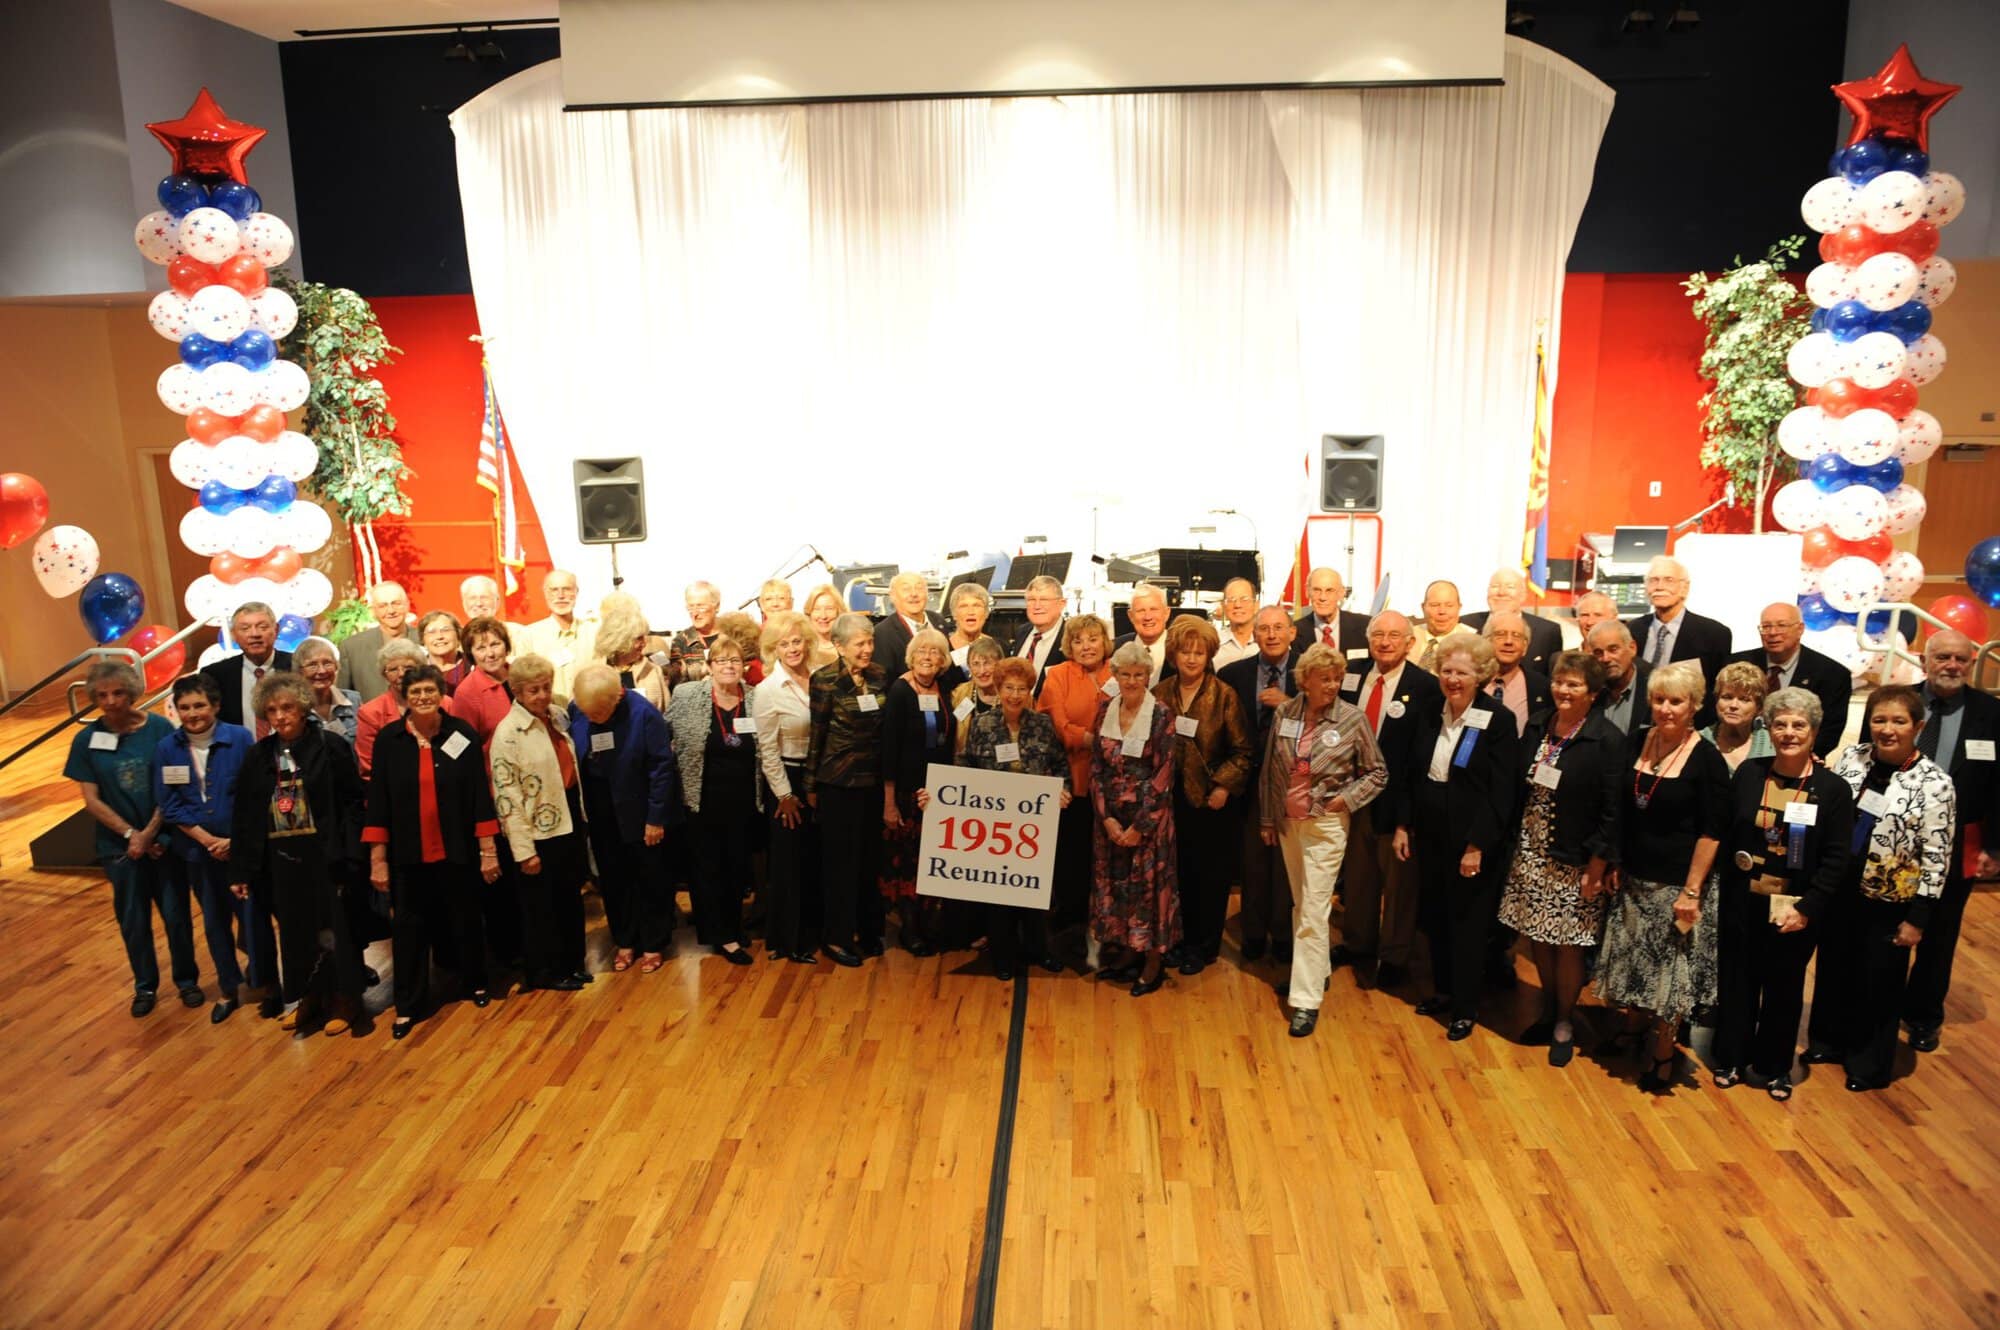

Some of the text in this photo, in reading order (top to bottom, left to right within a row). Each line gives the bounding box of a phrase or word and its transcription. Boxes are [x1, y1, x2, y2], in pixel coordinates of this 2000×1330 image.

[937, 785, 1050, 815] Class of
[938, 816, 1040, 860] 1958
[928, 857, 1040, 889] Reunion
